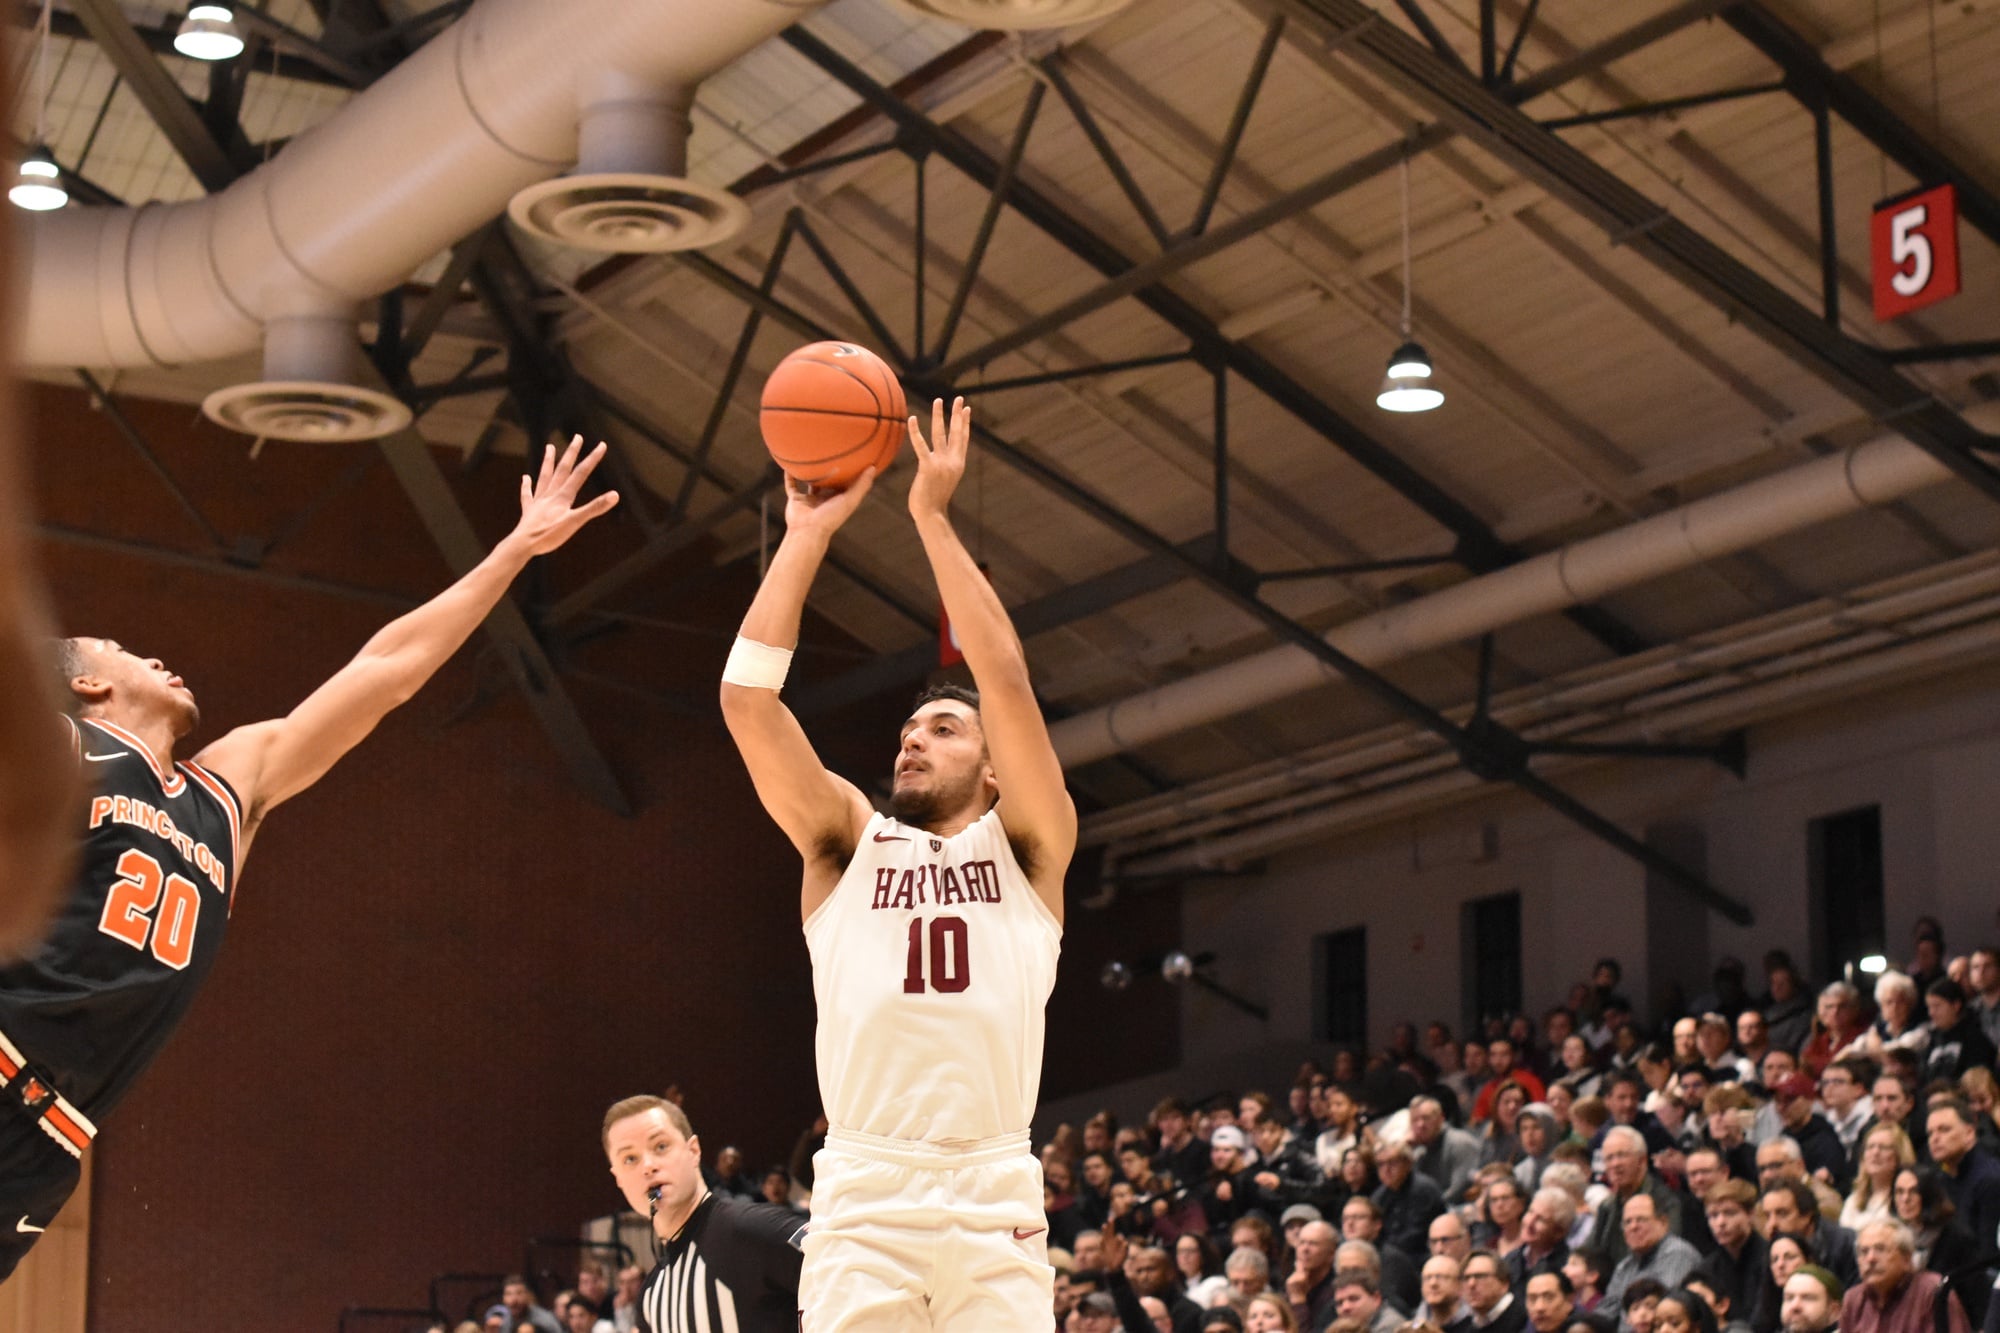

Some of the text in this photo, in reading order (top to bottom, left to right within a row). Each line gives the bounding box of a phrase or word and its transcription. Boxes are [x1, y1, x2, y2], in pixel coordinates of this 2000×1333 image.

[1891, 205, 1932, 296] 5
[98, 848, 201, 971] 20
[871, 860, 1001, 909] HARVARD
[904, 917, 970, 994] 10
